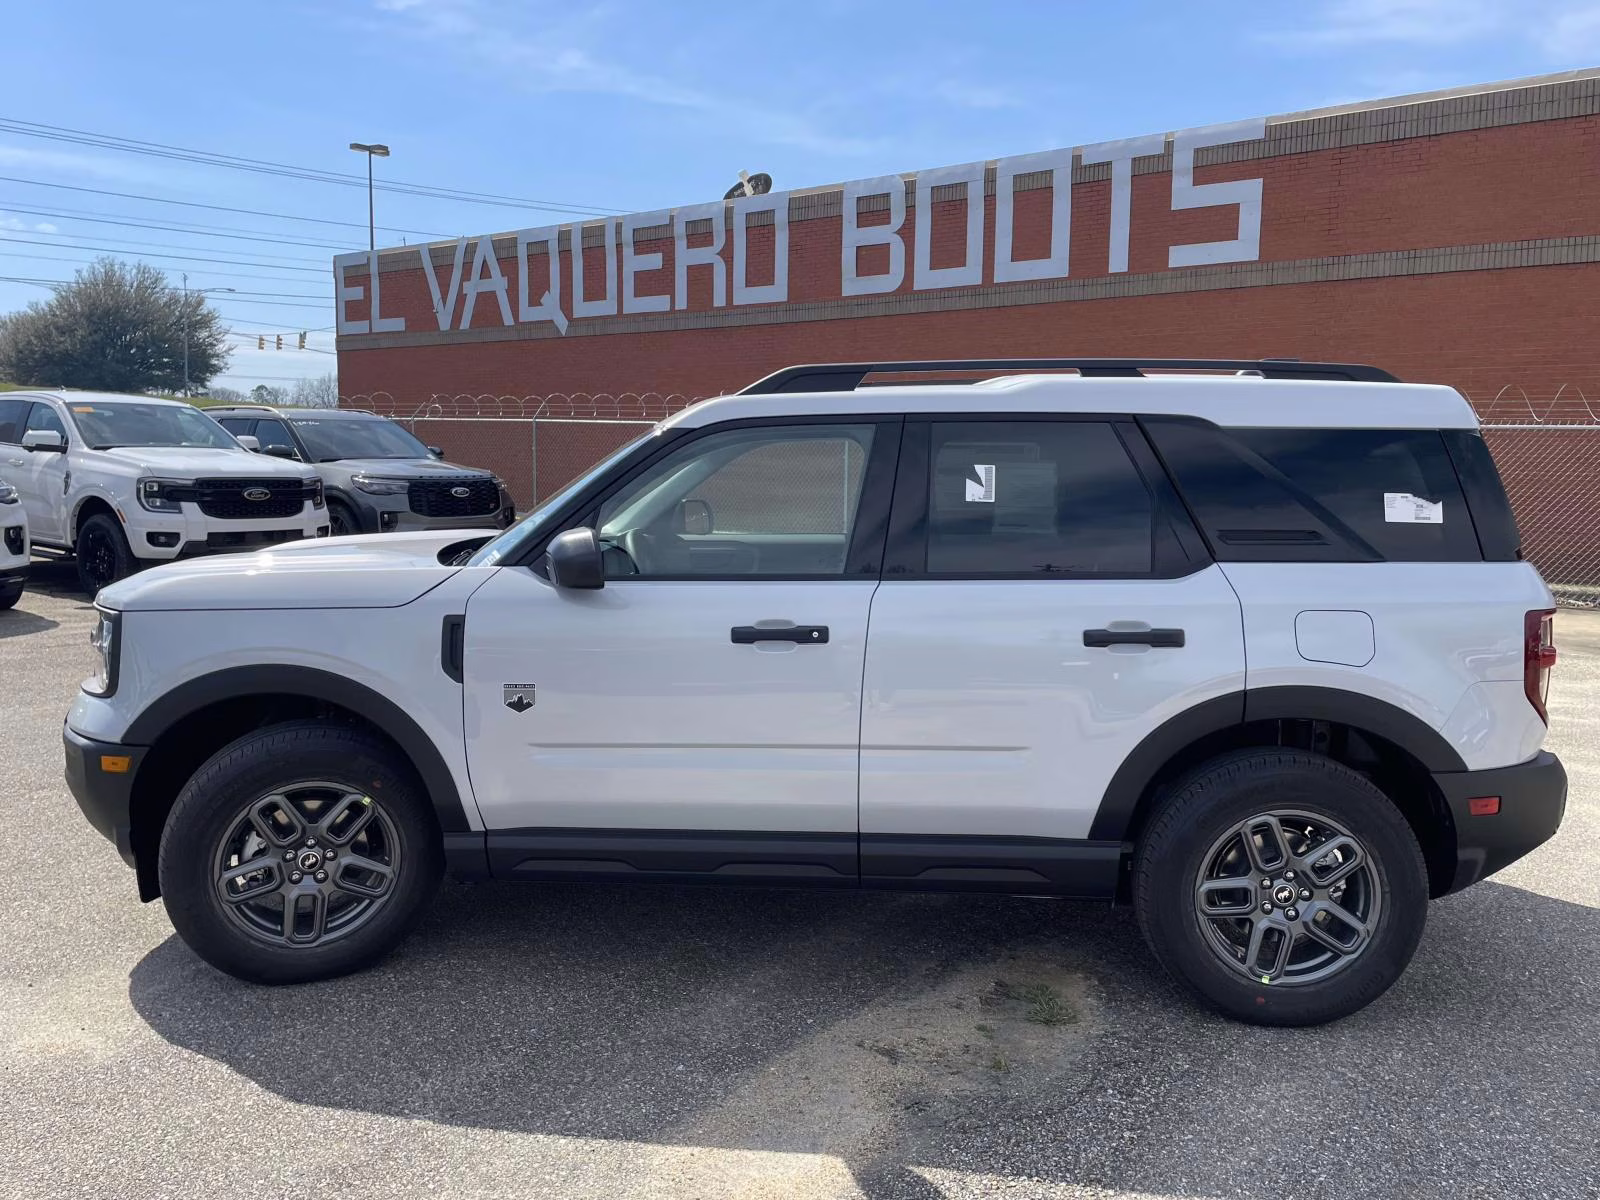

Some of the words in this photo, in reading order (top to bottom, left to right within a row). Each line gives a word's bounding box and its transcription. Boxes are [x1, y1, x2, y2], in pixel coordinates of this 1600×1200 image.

[334, 250, 405, 335] EL
[420, 192, 790, 335] VAQUERO
[842, 118, 1266, 296] BOOTS
